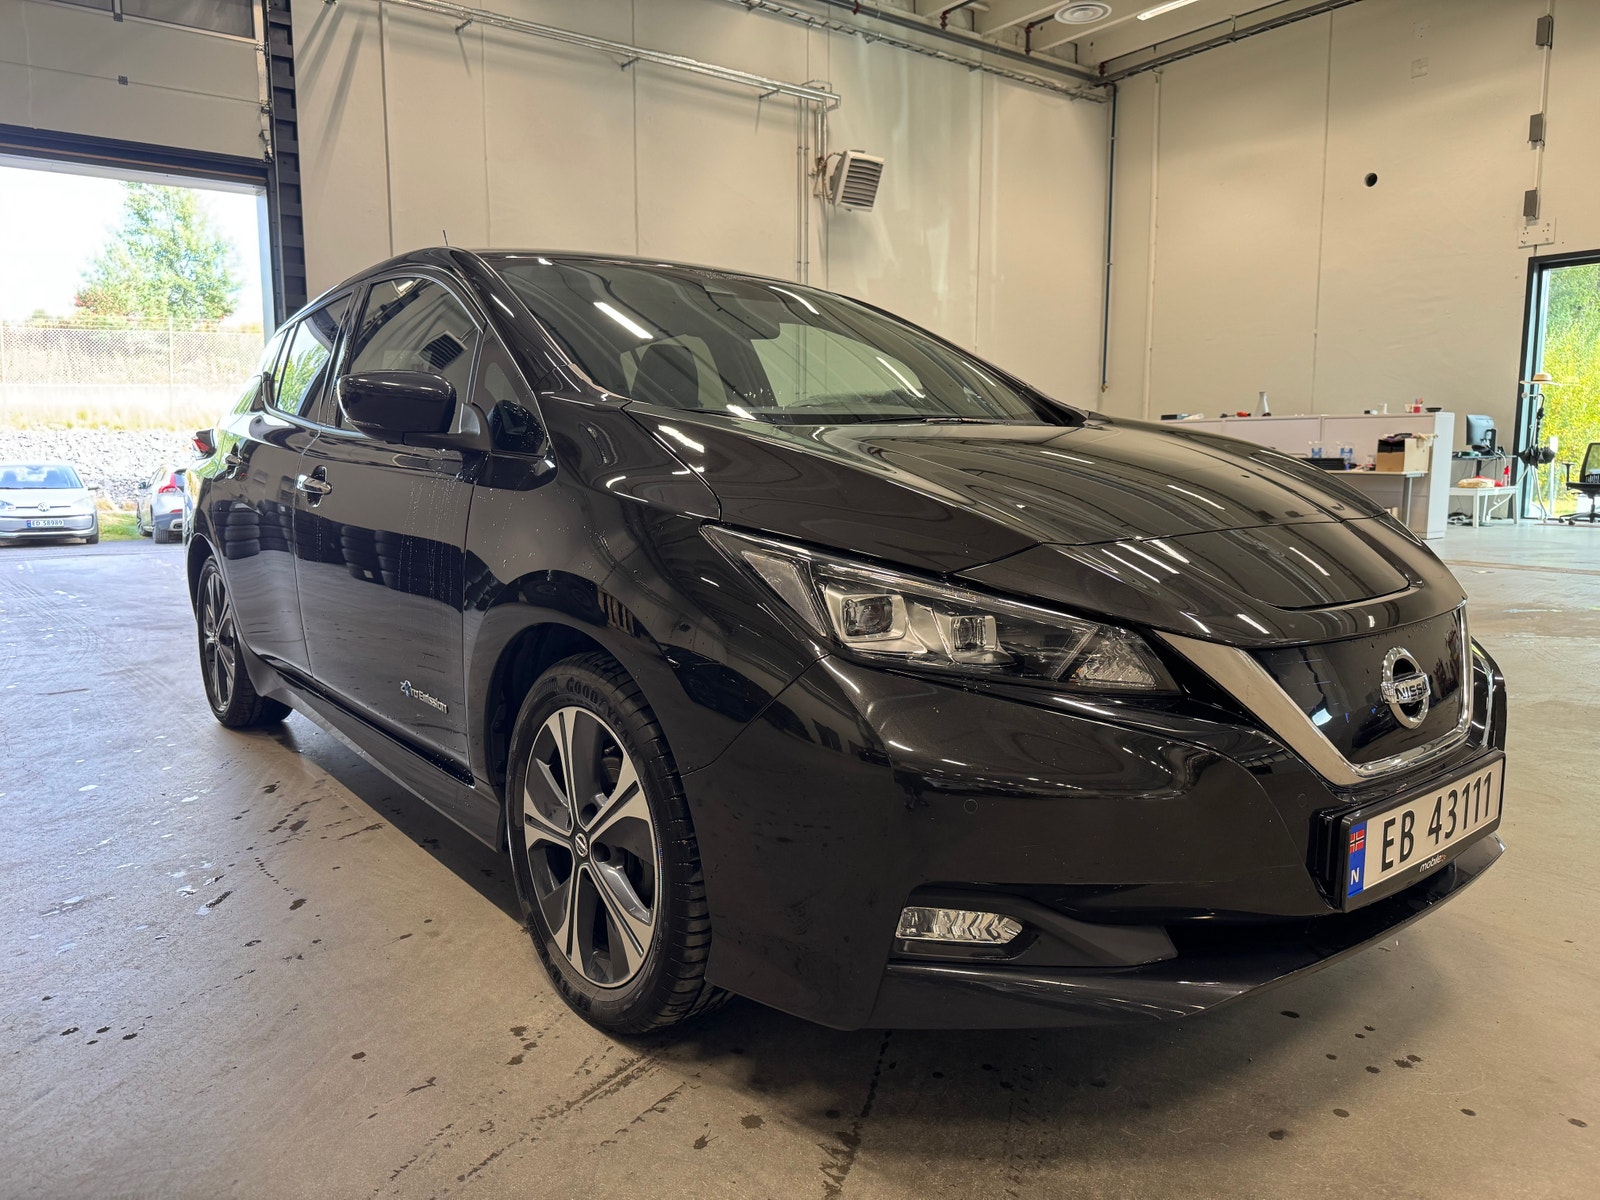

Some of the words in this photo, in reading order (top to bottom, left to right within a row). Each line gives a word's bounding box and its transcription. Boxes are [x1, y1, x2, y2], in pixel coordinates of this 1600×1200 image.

[1395, 681, 1427, 700] NISSA
[1381, 809, 1415, 873] EB
[1427, 771, 1492, 845] 43111
[1350, 867, 1360, 885] N
